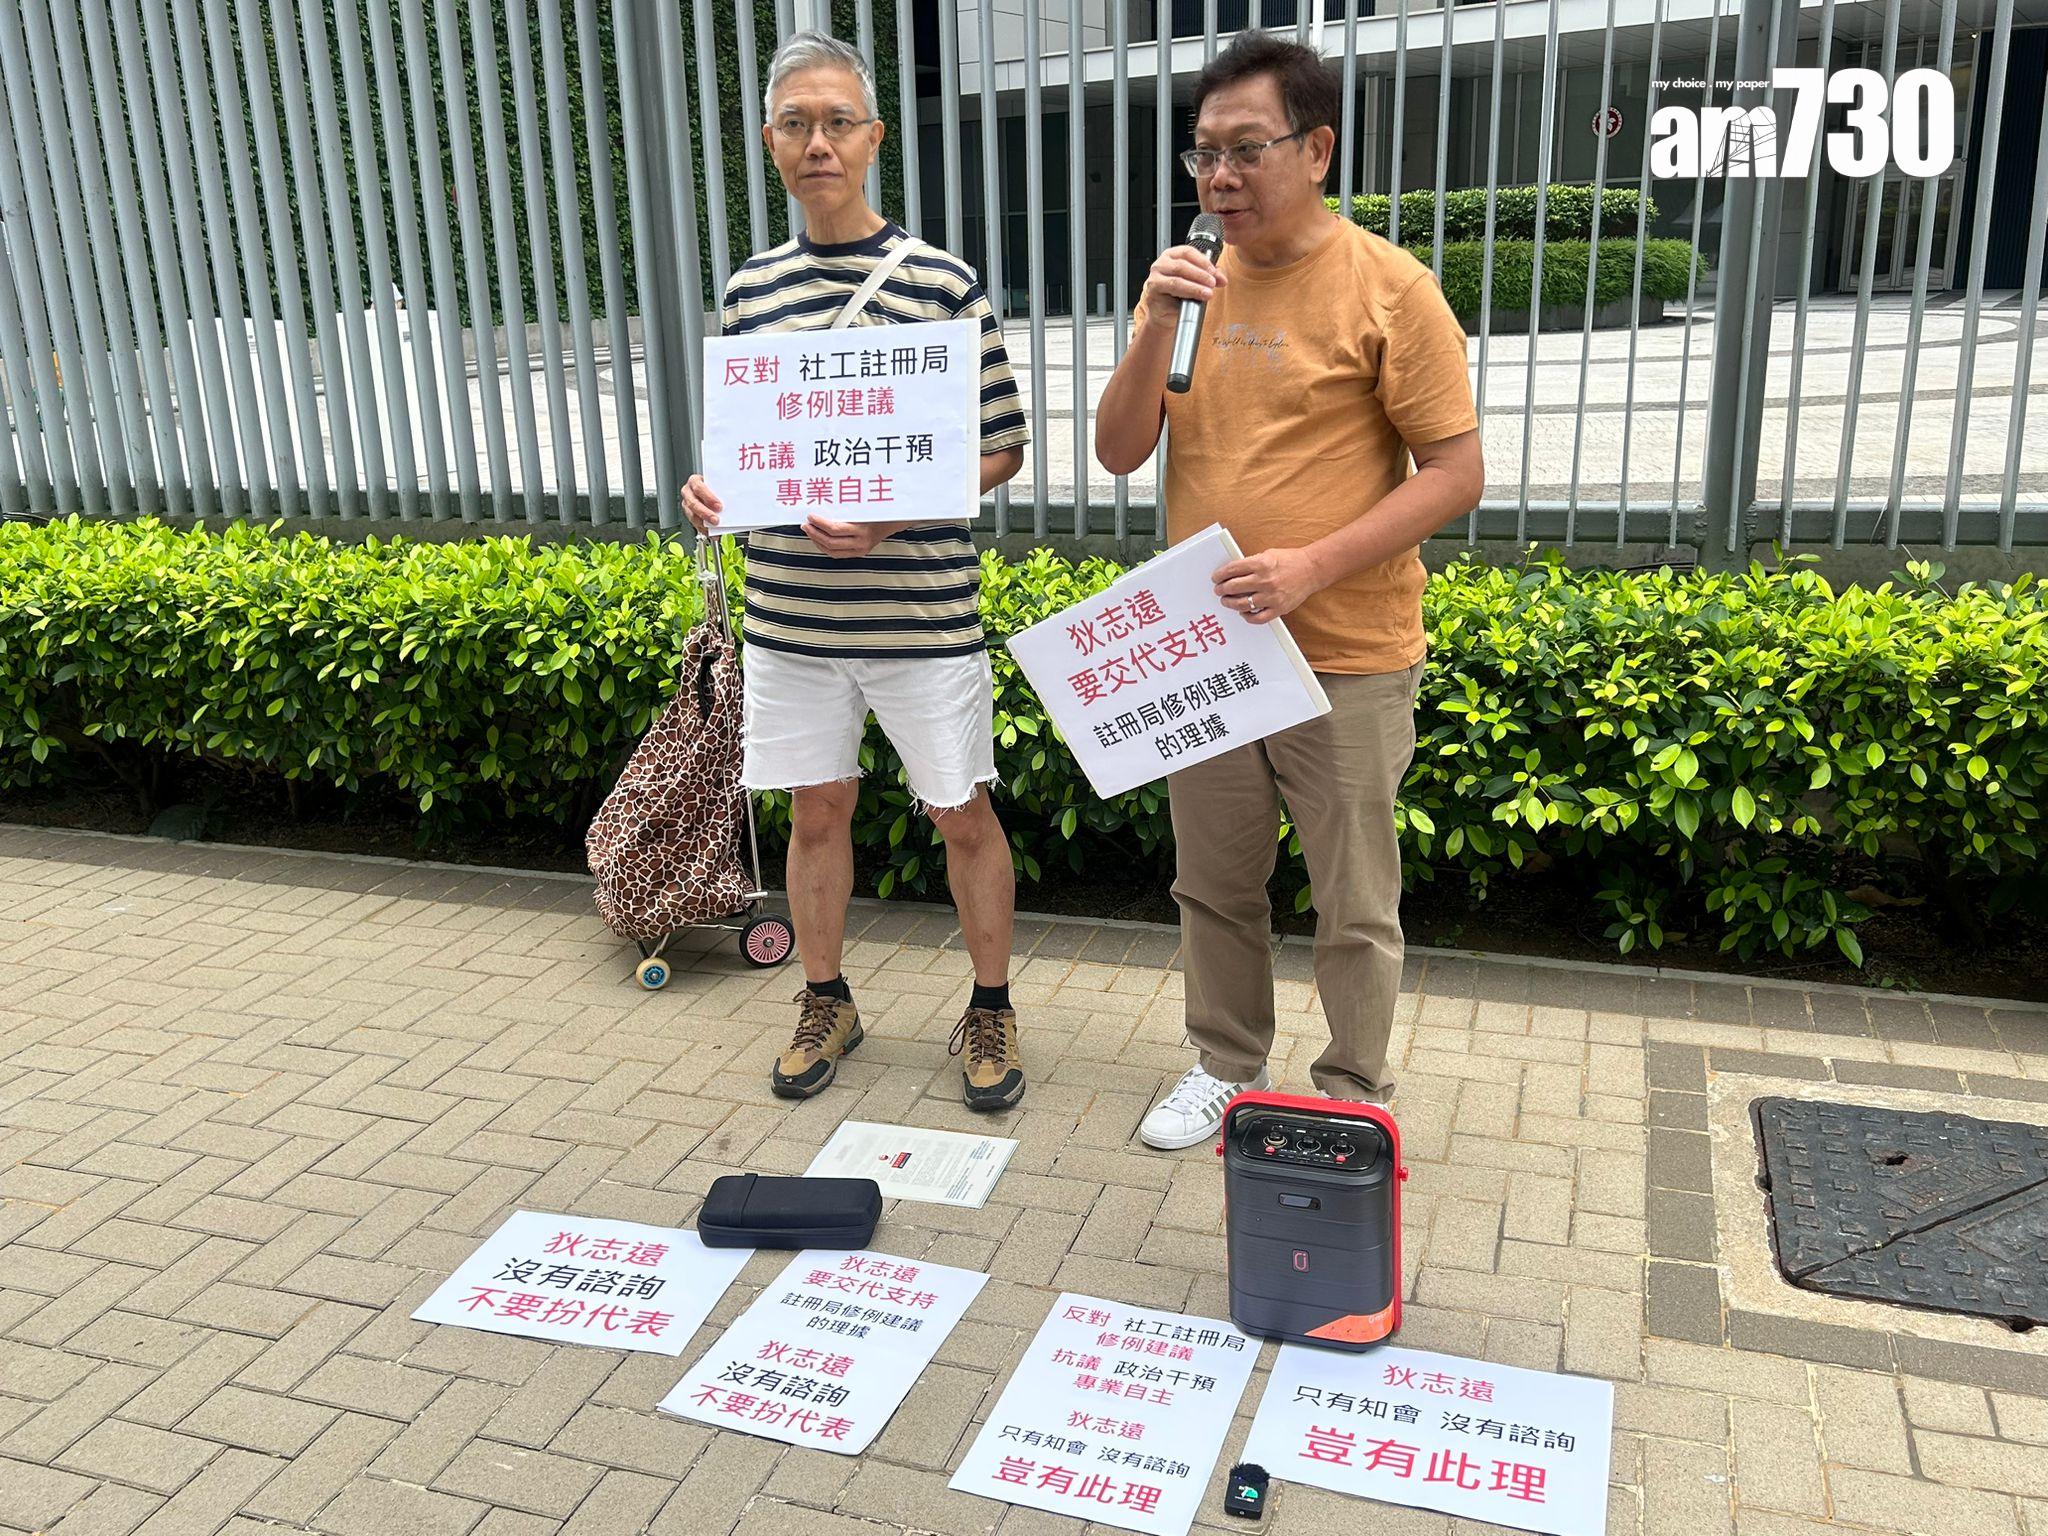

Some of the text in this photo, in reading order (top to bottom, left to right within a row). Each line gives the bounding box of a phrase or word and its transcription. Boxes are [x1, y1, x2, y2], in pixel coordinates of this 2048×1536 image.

[724, 344, 948, 386] 反對 社工註冊局
[776, 386, 894, 420] 修例建議
[739, 434, 933, 471] 抗議 政治干預
[776, 474, 894, 506] 專業自主
[1066, 588, 1166, 656] 狄志遠
[1068, 613, 1228, 706] 要交代支持
[1093, 662, 1259, 748] 註冊局修例建議
[1155, 713, 1230, 760] 的理據
[543, 1231, 669, 1267] 狄志遠
[840, 1255, 921, 1283] 狄志遠
[493, 1257, 666, 1300] 沒有諮詢
[803, 1269, 939, 1310] 要交代支持
[458, 1287, 675, 1337] 不要扮代表
[780, 1292, 924, 1333] 註冊局修例建議
[806, 1316, 871, 1339] 的理據
[1062, 1305, 1246, 1352] 反對 社工註冊局
[756, 1340, 855, 1378] 狄志遠
[1096, 1332, 1194, 1362] 修例建議
[717, 1360, 850, 1407] 沒有諮詢
[1051, 1348, 1218, 1393] 抗議 政治干預
[1072, 1373, 1175, 1406] 專業自主
[1382, 1364, 1495, 1403] 狄志遠
[690, 1384, 855, 1441] 不要扮代表
[1067, 1410, 1146, 1440] 狄志遠
[1292, 1385, 1576, 1453] 只有知會 沒有諮詢
[998, 1425, 1191, 1479] 只有知會 沒有諮詢
[1298, 1424, 1547, 1504] 豈有此理
[992, 1455, 1162, 1515] 豈有此理
